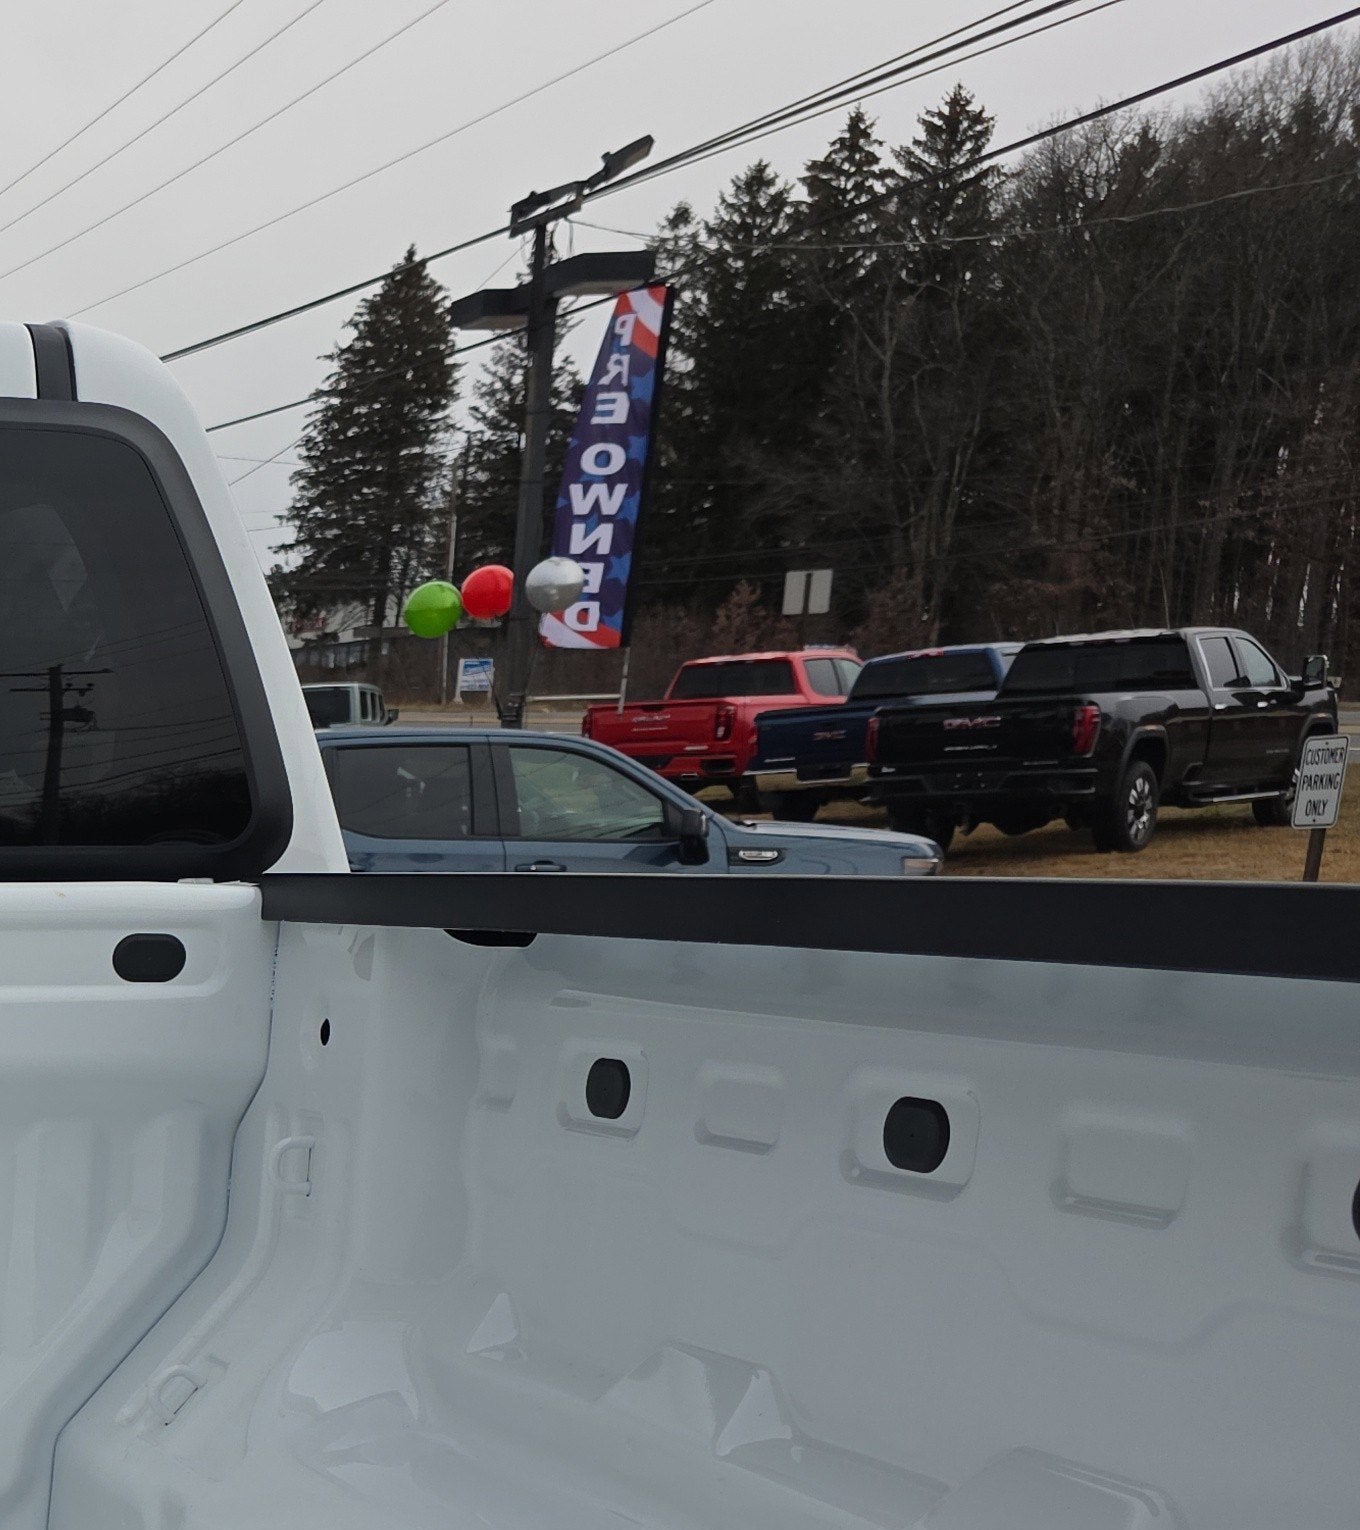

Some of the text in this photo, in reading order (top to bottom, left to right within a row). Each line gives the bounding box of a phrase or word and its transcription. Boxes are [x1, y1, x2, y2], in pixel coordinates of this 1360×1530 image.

[1305, 747, 1345, 766] CUSTOMER
[1301, 772, 1340, 791] PARKING
[1305, 799, 1328, 817] ONLY
